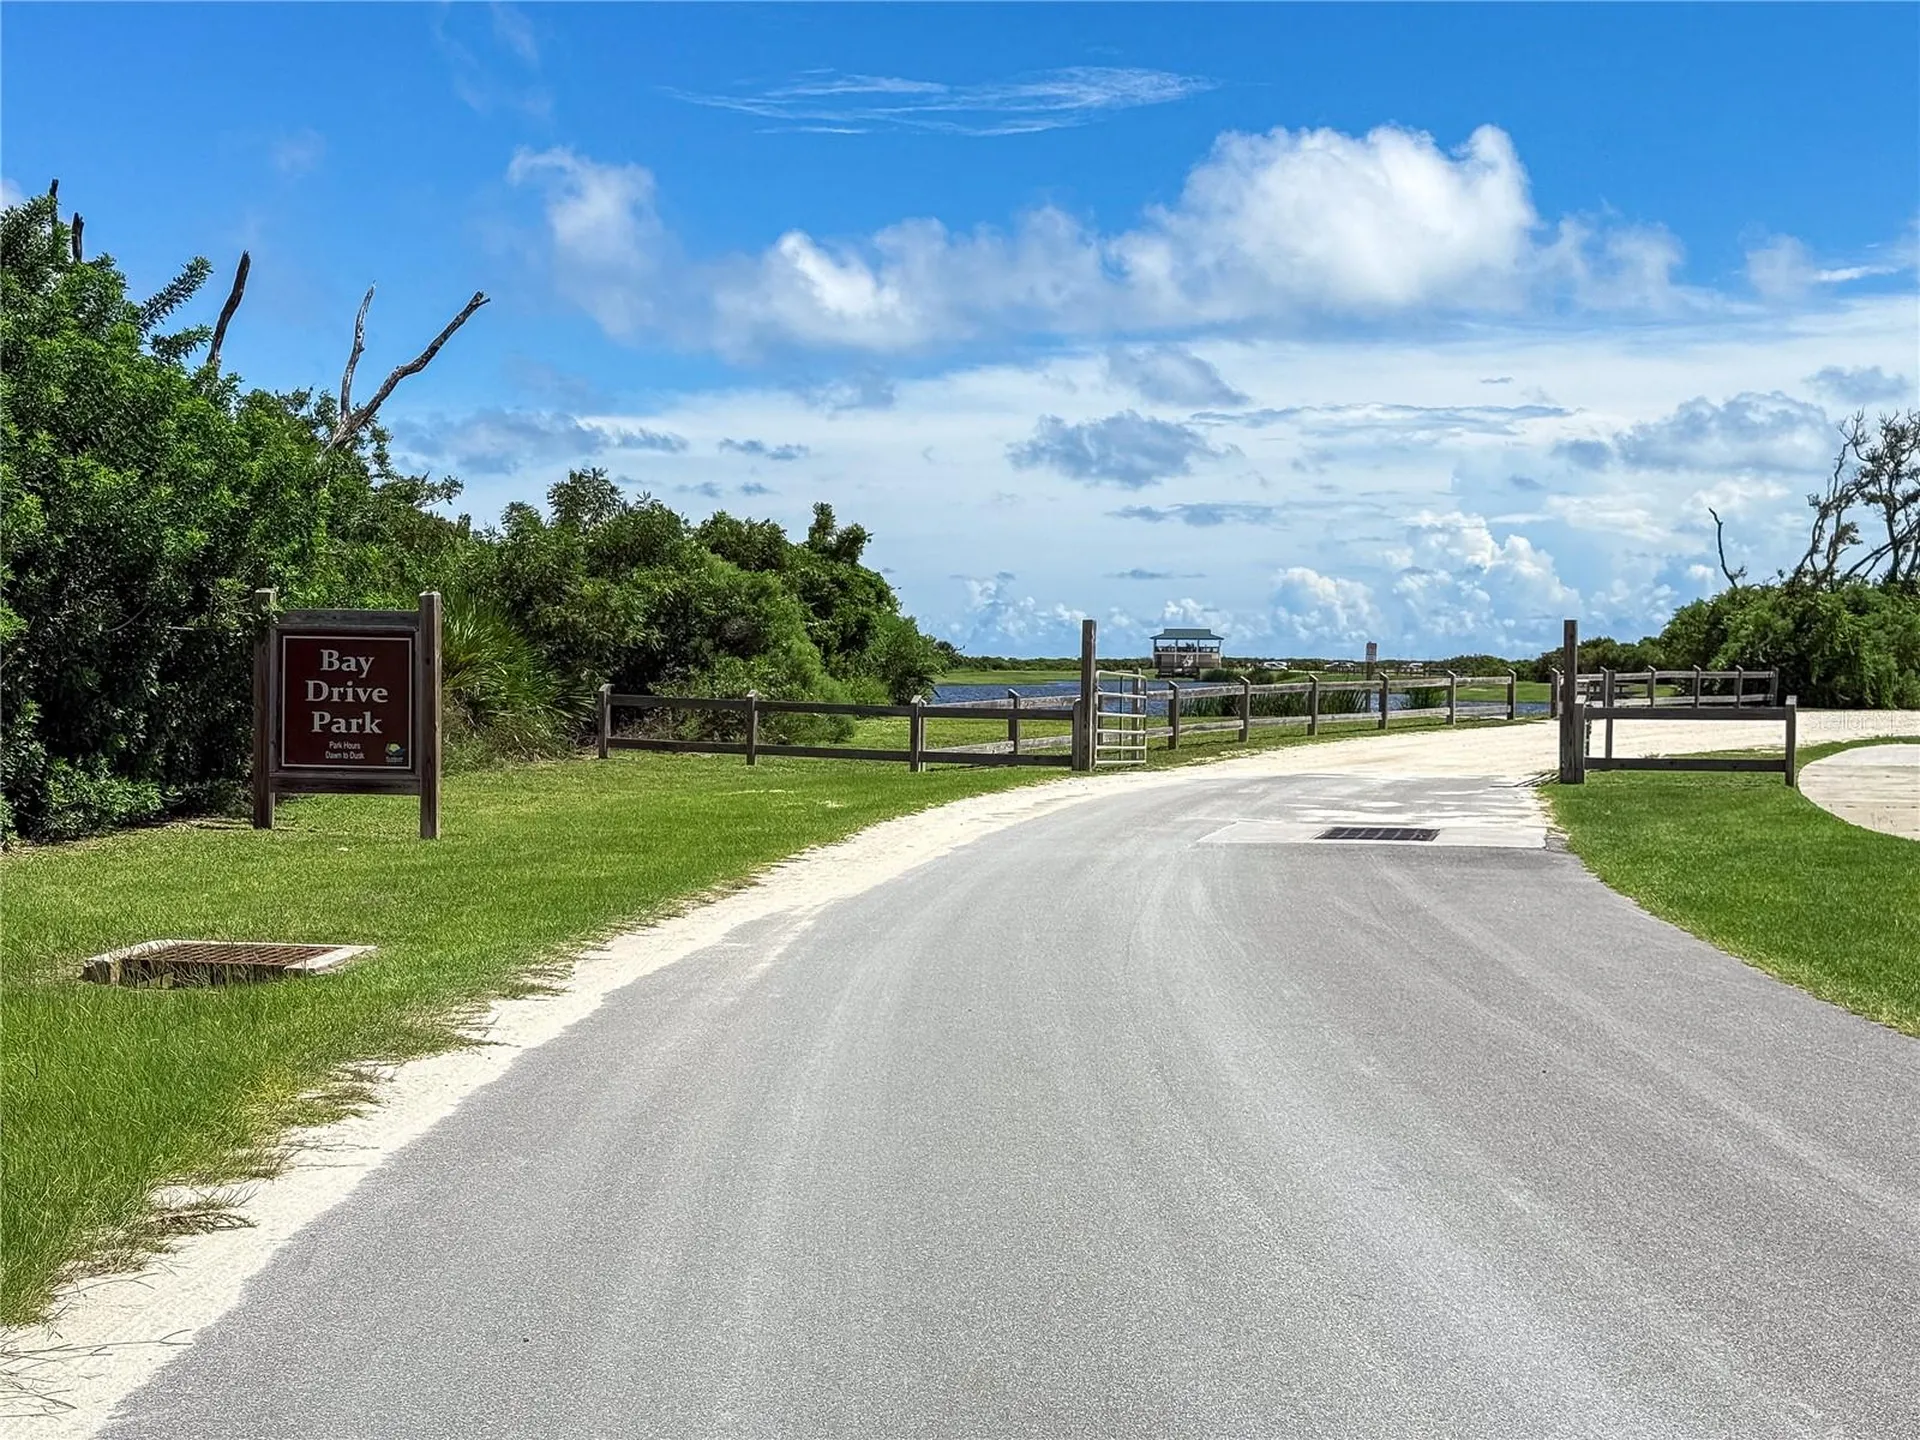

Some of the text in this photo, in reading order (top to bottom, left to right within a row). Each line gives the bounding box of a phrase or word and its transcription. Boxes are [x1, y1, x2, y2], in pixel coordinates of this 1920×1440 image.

[320, 649, 375, 678] Bay
[305, 680, 389, 703] Drive
[311, 711, 383, 734] Park
[325, 750, 365, 759] Dawn to Dusk
[329, 741, 361, 750] Park Hours
